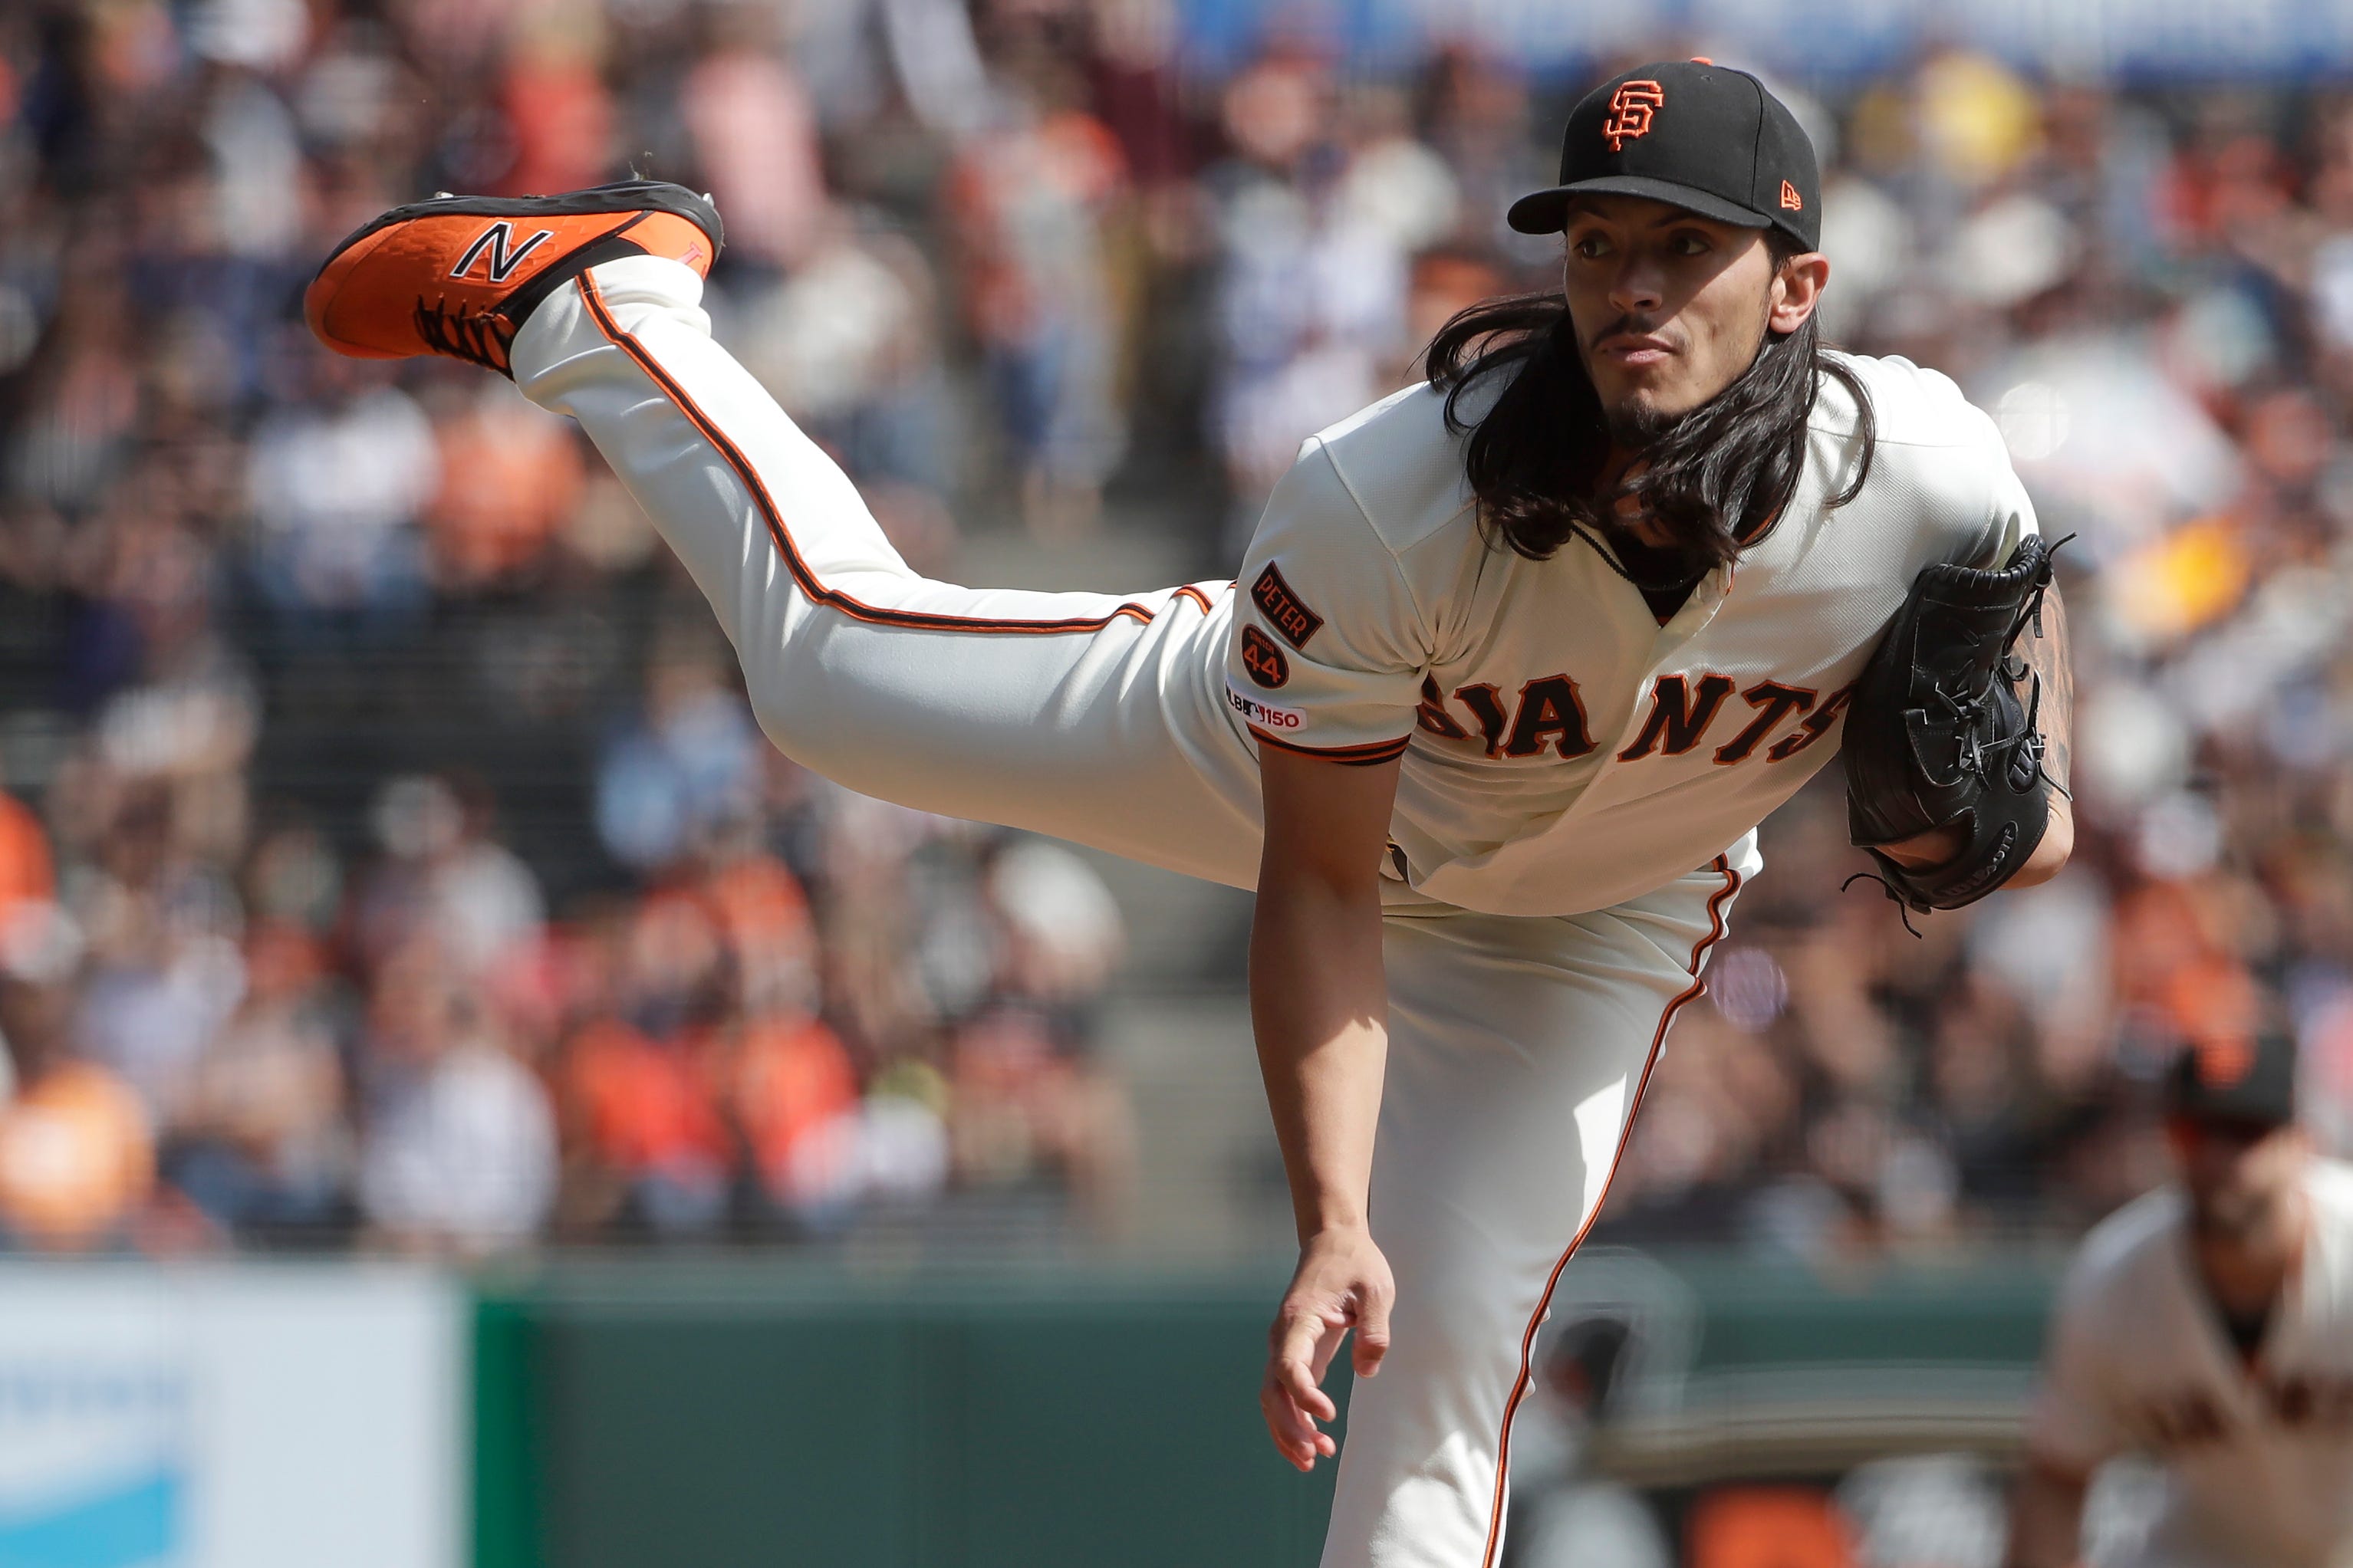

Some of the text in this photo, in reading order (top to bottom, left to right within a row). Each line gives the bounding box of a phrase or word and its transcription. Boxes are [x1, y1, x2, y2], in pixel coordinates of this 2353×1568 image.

[1601, 81, 1664, 151] SF
[449, 220, 555, 283] N
[1258, 575, 1307, 638] PETER
[1244, 644, 1281, 682] 44
[1226, 681, 1299, 728] LB 150
